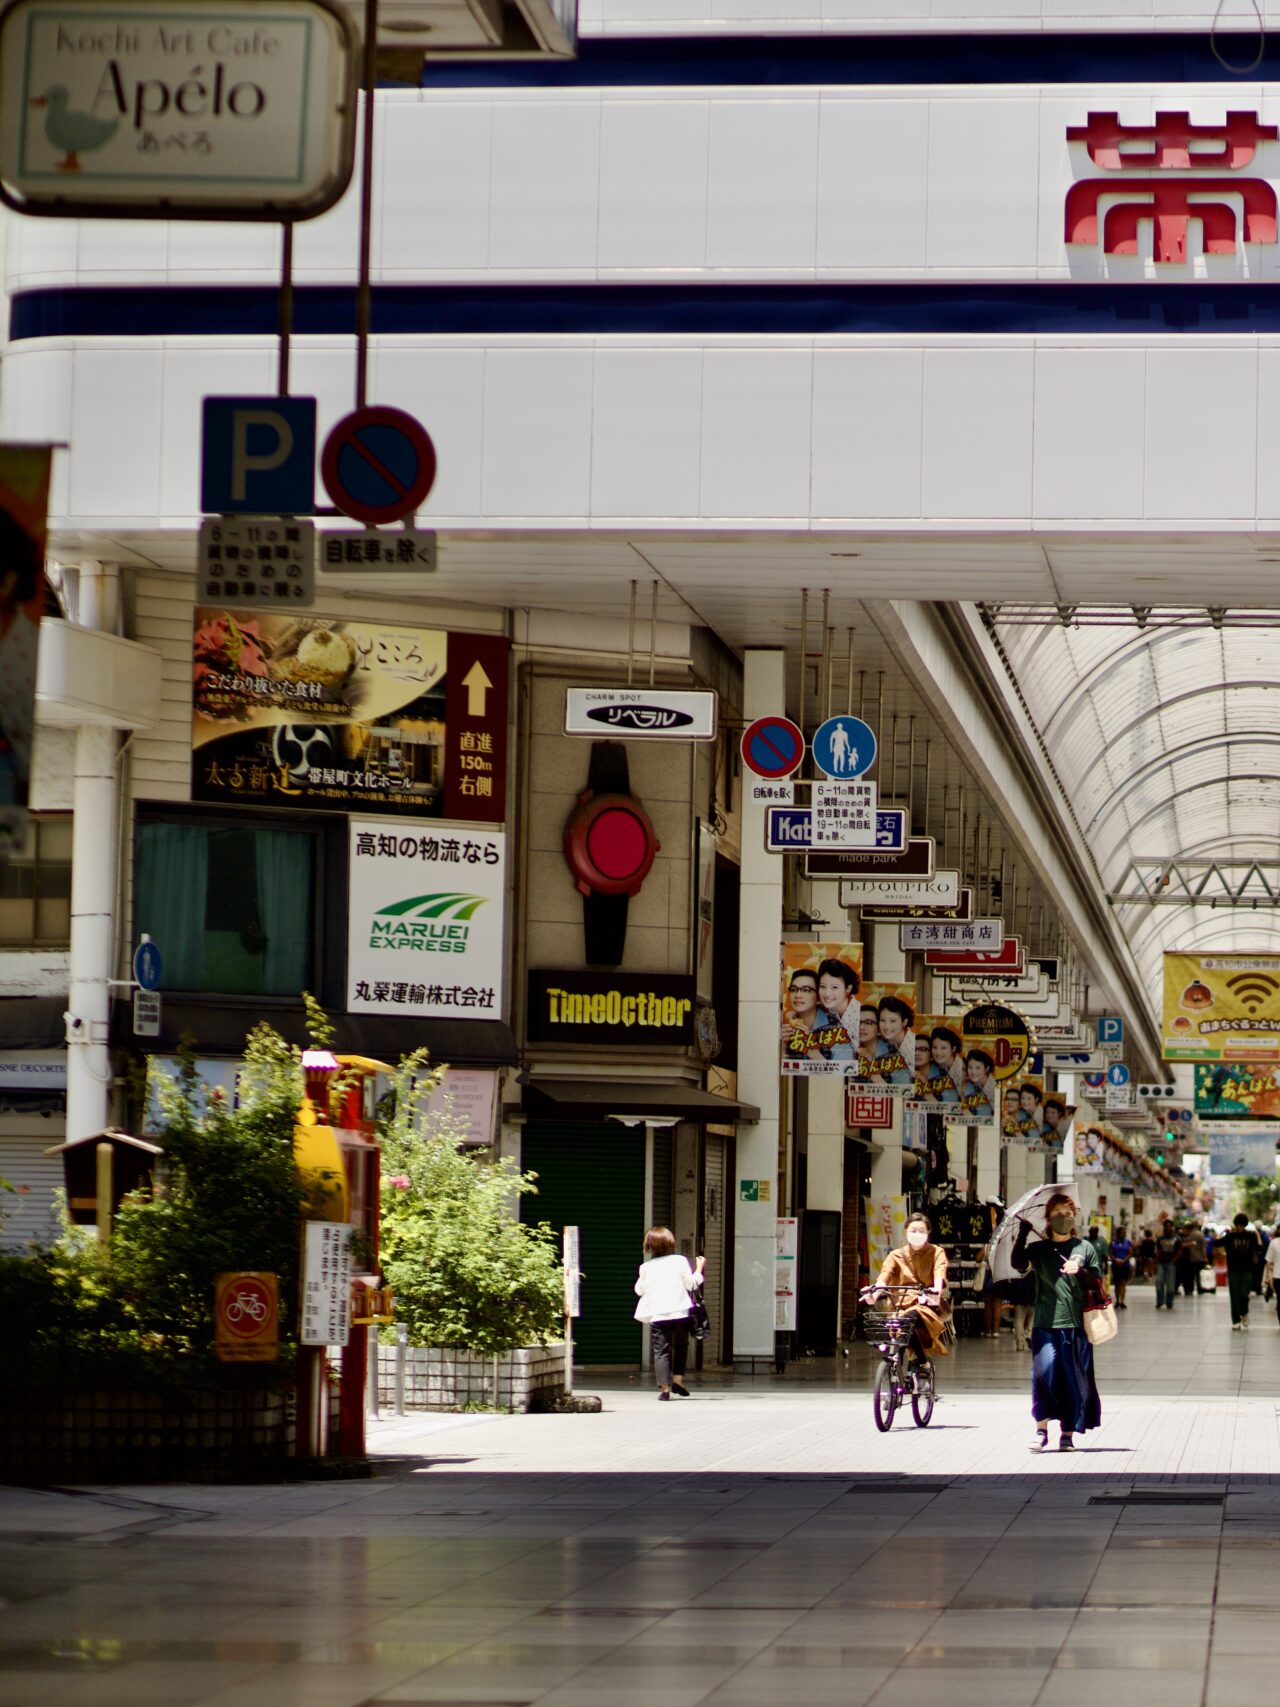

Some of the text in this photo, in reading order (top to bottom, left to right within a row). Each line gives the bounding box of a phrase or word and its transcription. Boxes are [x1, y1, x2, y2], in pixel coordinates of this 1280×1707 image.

[90, 59, 267, 131] Apélo
[230, 408, 294, 501] P
[326, 538, 429, 564] 自転車を除く
[206, 674, 324, 699] こだわり抜いた食材
[585, 692, 643, 703] CHARM SPOT
[607, 706, 678, 728] リベラル
[459, 731, 494, 754] 直進
[459, 754, 494, 772] 150m
[307, 766, 414, 791] 帯屋町文化ホール
[458, 774, 494, 797] 右側
[752, 786, 792, 799] 自転車を除く
[355, 831, 500, 866] 高知の物流なら
[371, 920, 470, 940] MARUEI
[369, 936, 468, 954] EXPRESS
[353, 979, 496, 1009] 丸榮運輸株式会社
[969, 1016, 1014, 1029] PREMIUM
[1103, 1019, 1119, 1040] P
[960, 1094, 987, 1110] んぱん
